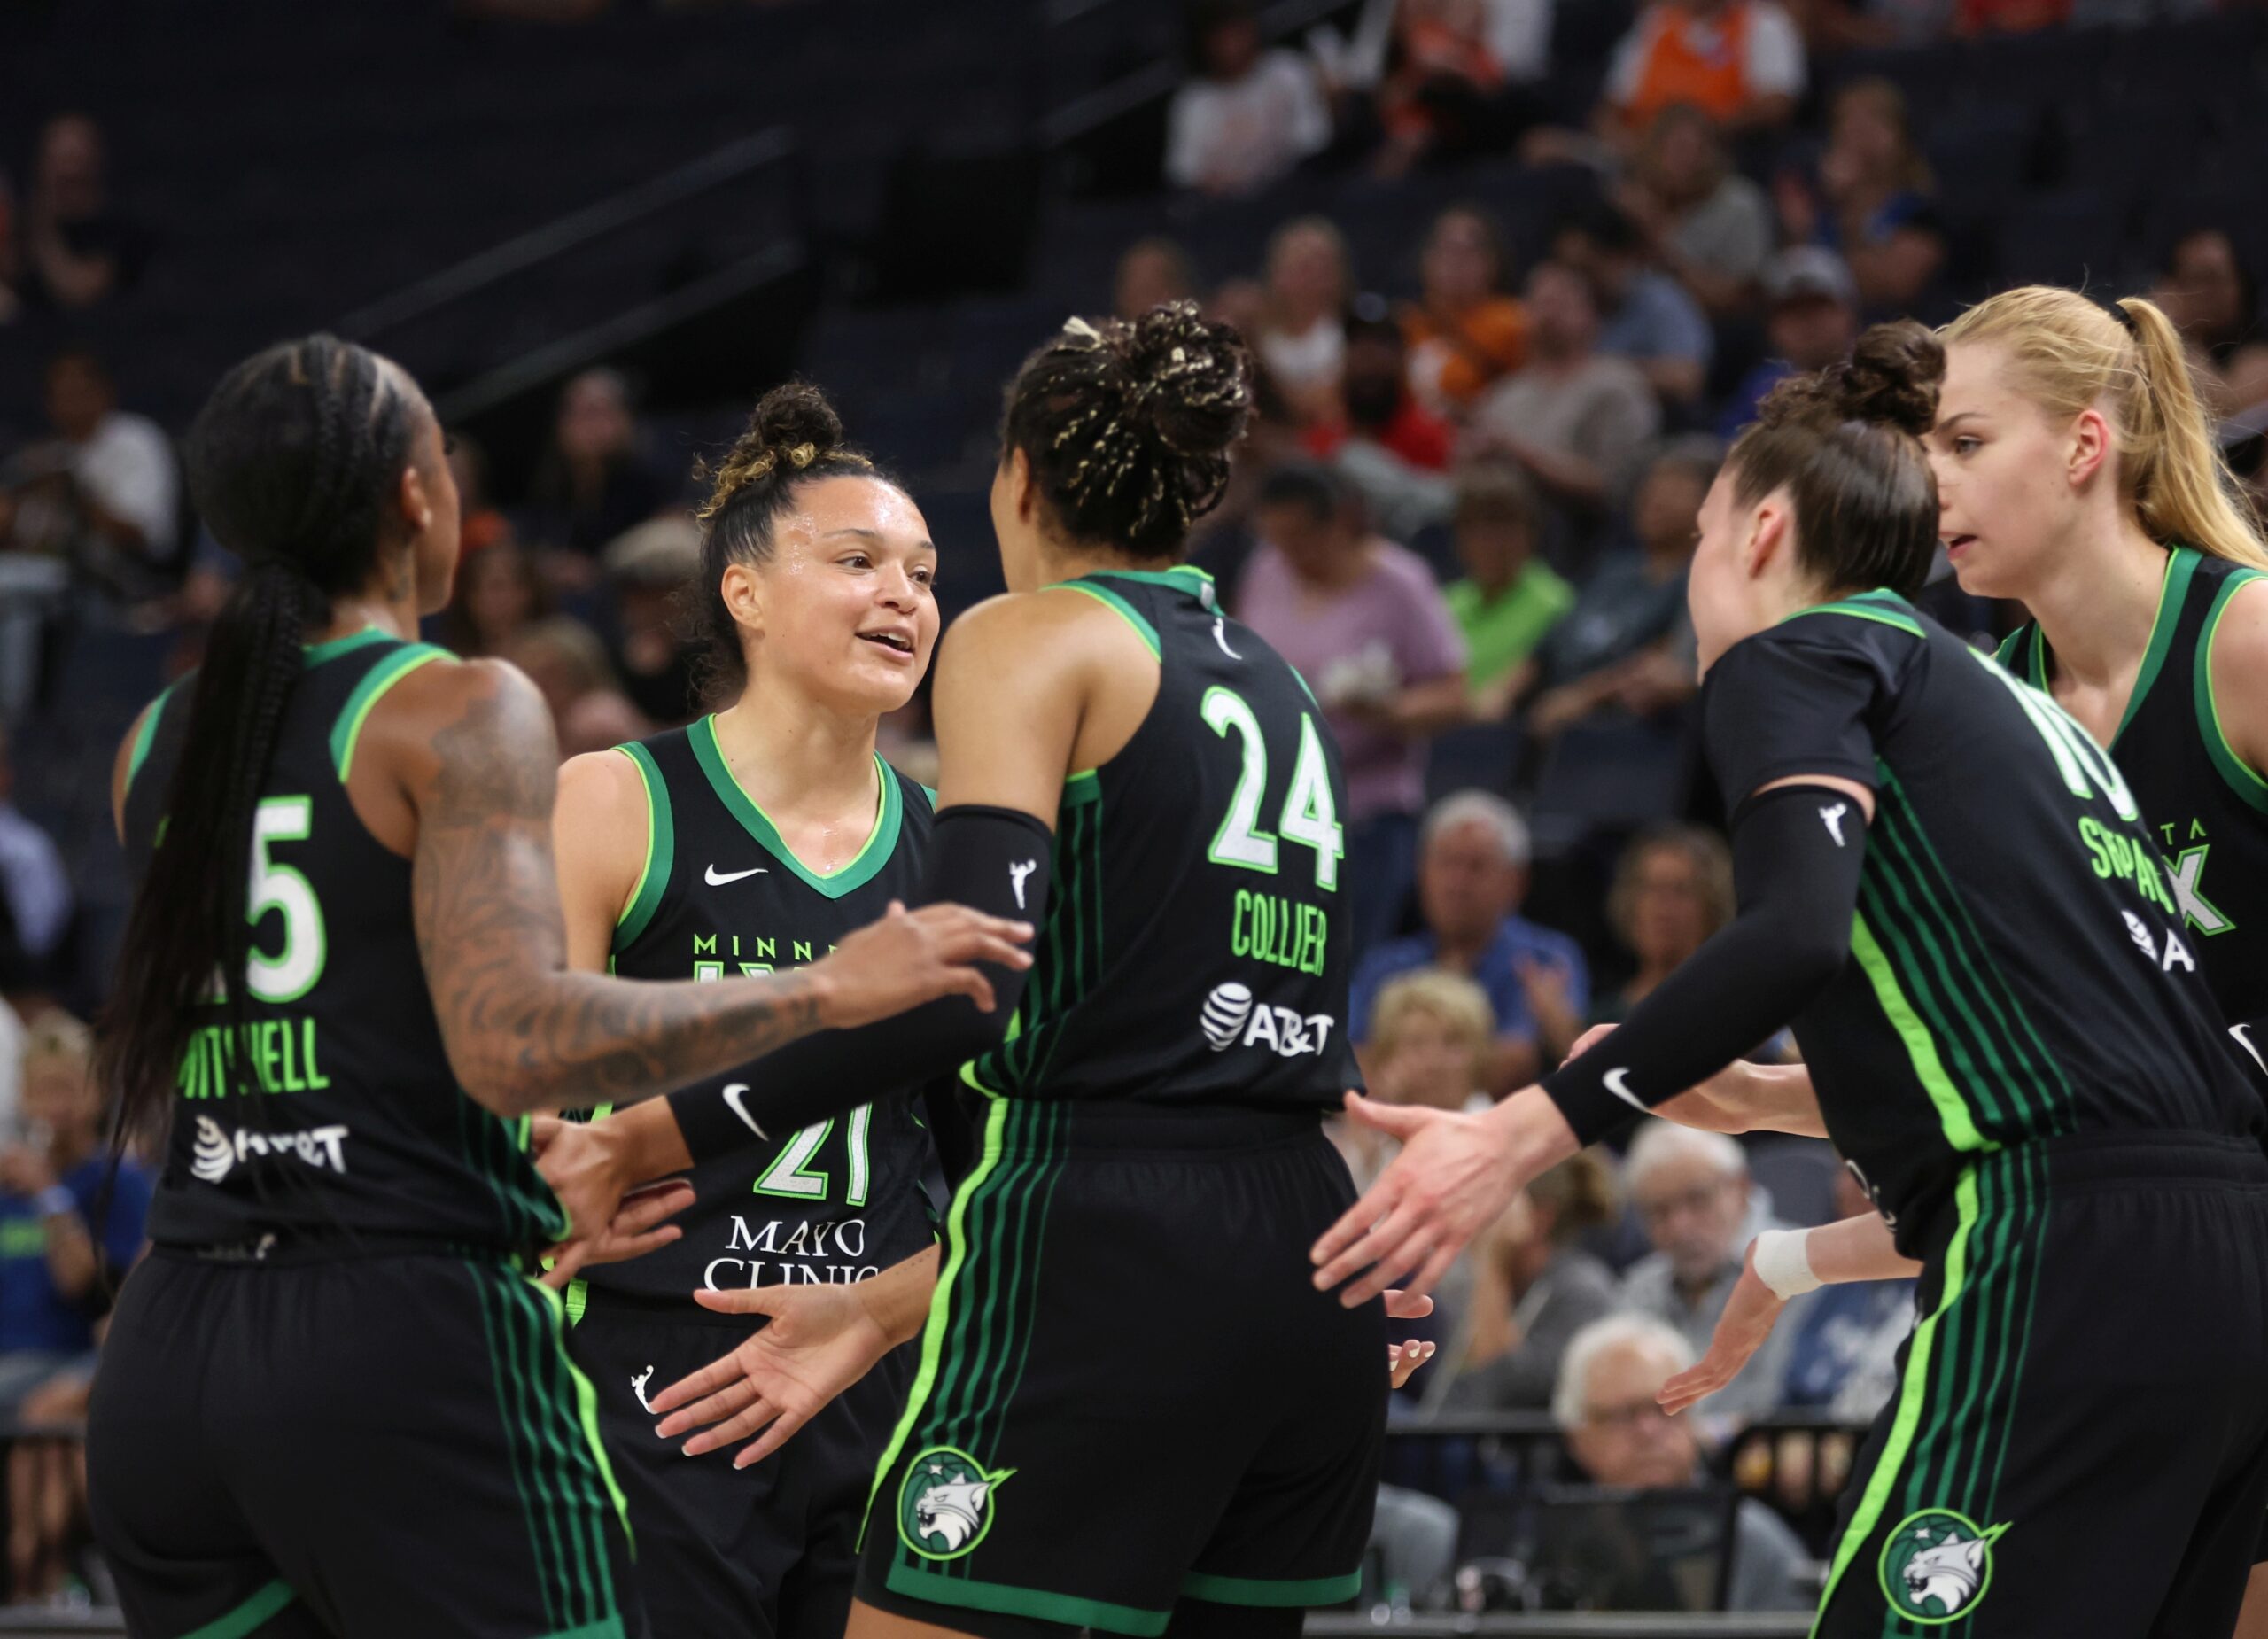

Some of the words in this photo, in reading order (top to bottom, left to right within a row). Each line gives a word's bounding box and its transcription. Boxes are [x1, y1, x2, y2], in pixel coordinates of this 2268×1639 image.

[1200, 685, 1345, 892] 24
[694, 933, 838, 962] MINN
[1231, 889, 1327, 976] COLLIER
[1243, 1002, 1334, 1057] AT&T
[724, 1215, 866, 1257] MAYO
